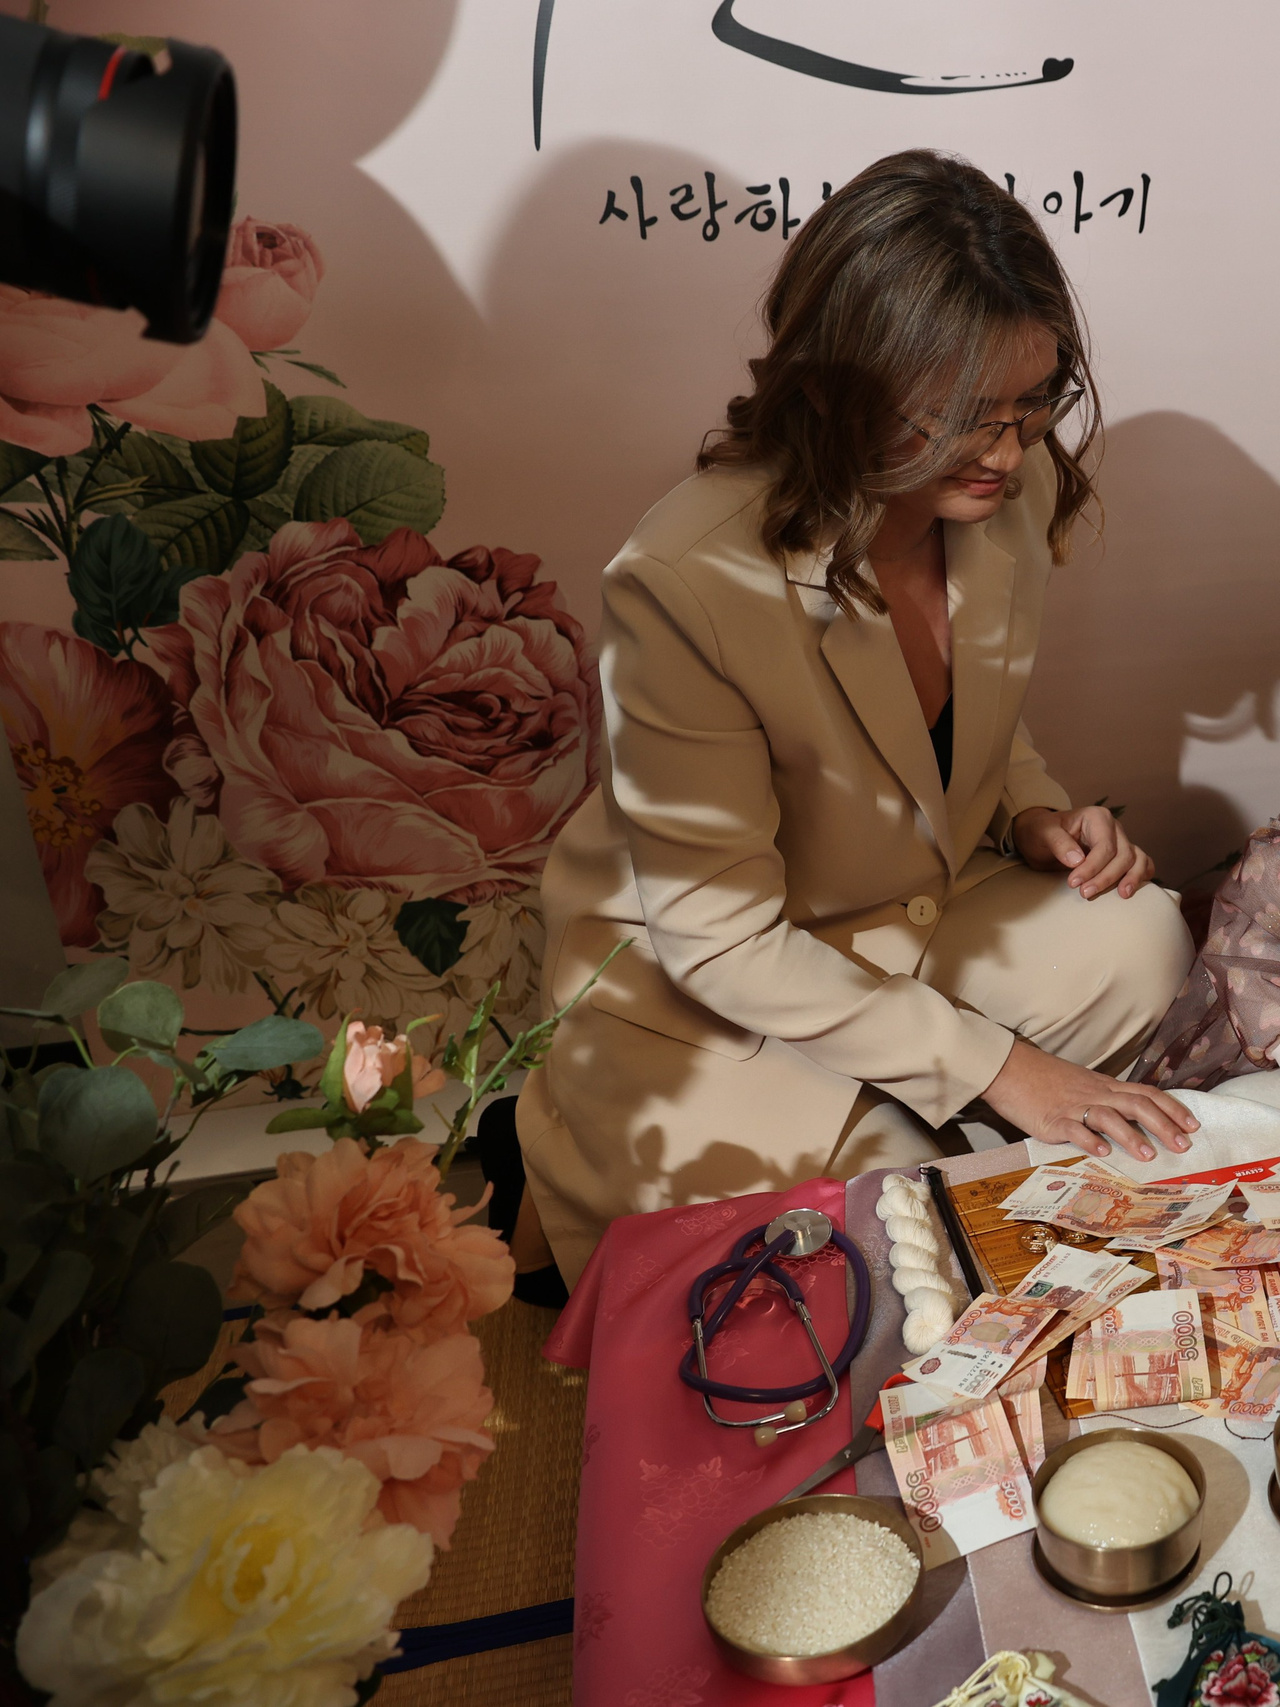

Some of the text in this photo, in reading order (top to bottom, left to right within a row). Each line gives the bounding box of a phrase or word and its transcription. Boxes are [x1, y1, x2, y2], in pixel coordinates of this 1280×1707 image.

[598, 171, 834, 242] 사랑하
[1081, 1183, 1123, 1198] 5000
[1234, 1167, 1264, 1178] CLEVER
[1031, 1254, 1059, 1280] РОССИИ
[944, 1309, 983, 1347] 5000
[1172, 1311, 1200, 1362] 5000
[1229, 1402, 1275, 1417] 5000
[905, 1468, 943, 1533] 5000
[1001, 1480, 1024, 1518] 5000
